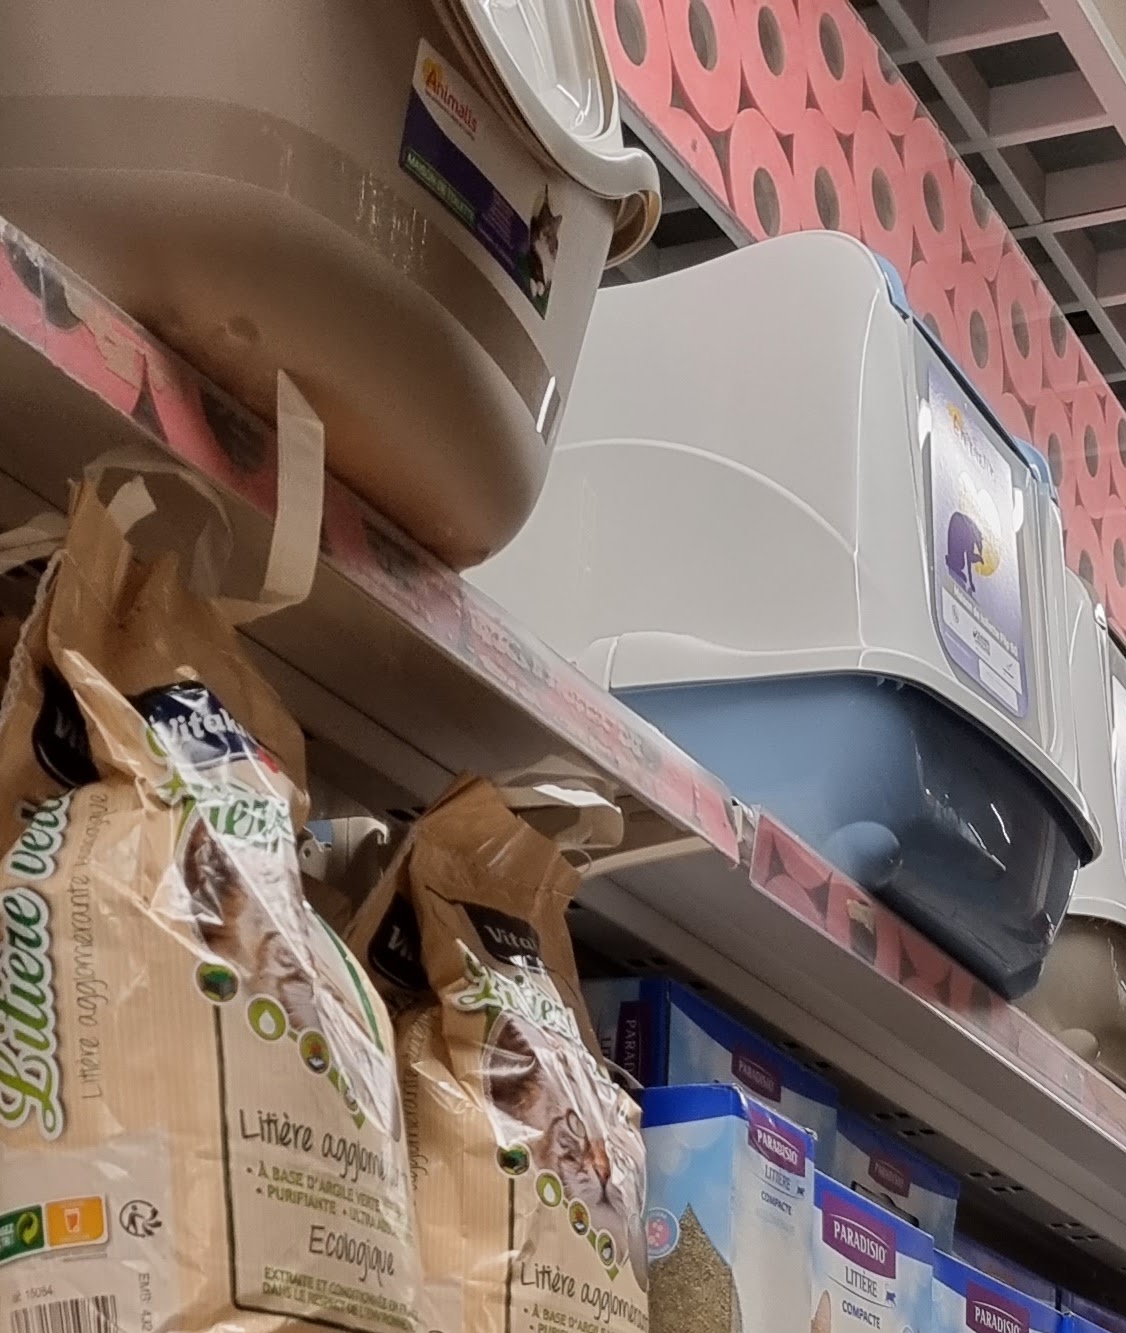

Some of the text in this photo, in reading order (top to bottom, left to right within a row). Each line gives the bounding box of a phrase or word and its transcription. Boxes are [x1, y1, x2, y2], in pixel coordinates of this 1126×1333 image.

[424, 68, 478, 134] Animalis
[239, 1108, 314, 1153] Litière
[756, 1129, 799, 1166] PARADISIO
[272, 1165, 304, 1188] BASE
[309, 1223, 395, 1288] Ecologique
[833, 1219, 888, 1265] PARADISIO
[519, 1261, 576, 1299] Litière
[845, 1265, 878, 1299] LITIÈRE
[543, 1307, 566, 1327] BASE
[841, 1299, 881, 1330] COMPACTE
